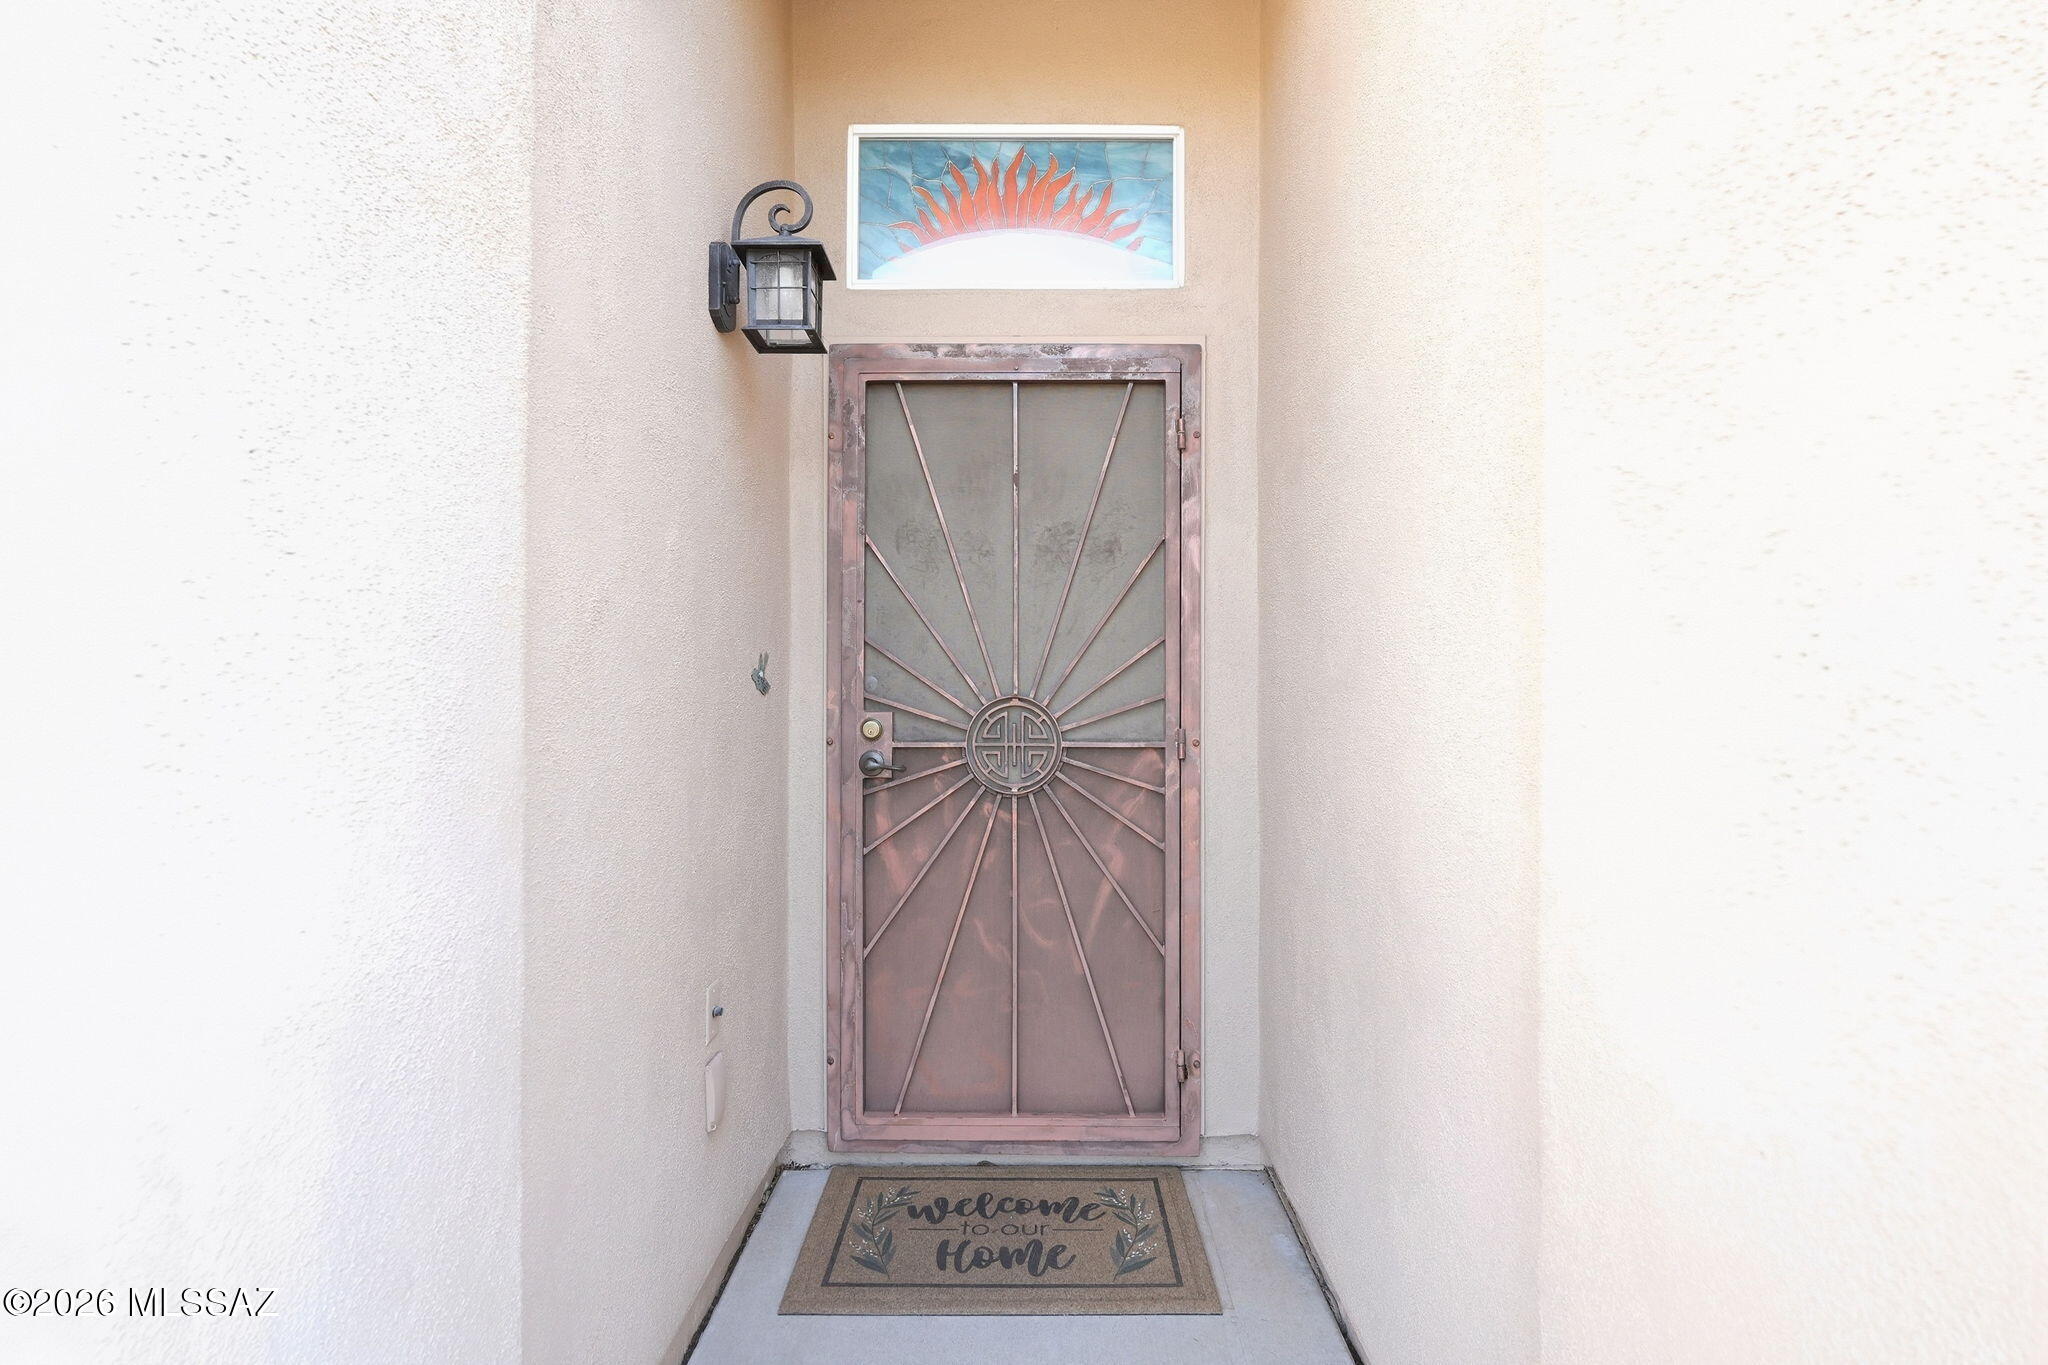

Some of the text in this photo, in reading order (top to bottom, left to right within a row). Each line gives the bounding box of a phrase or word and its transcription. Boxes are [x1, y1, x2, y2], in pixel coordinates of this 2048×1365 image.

[905, 1191, 1107, 1224] welcome
[960, 1222, 1050, 1236] to our
[936, 1238, 1077, 1277] Home
